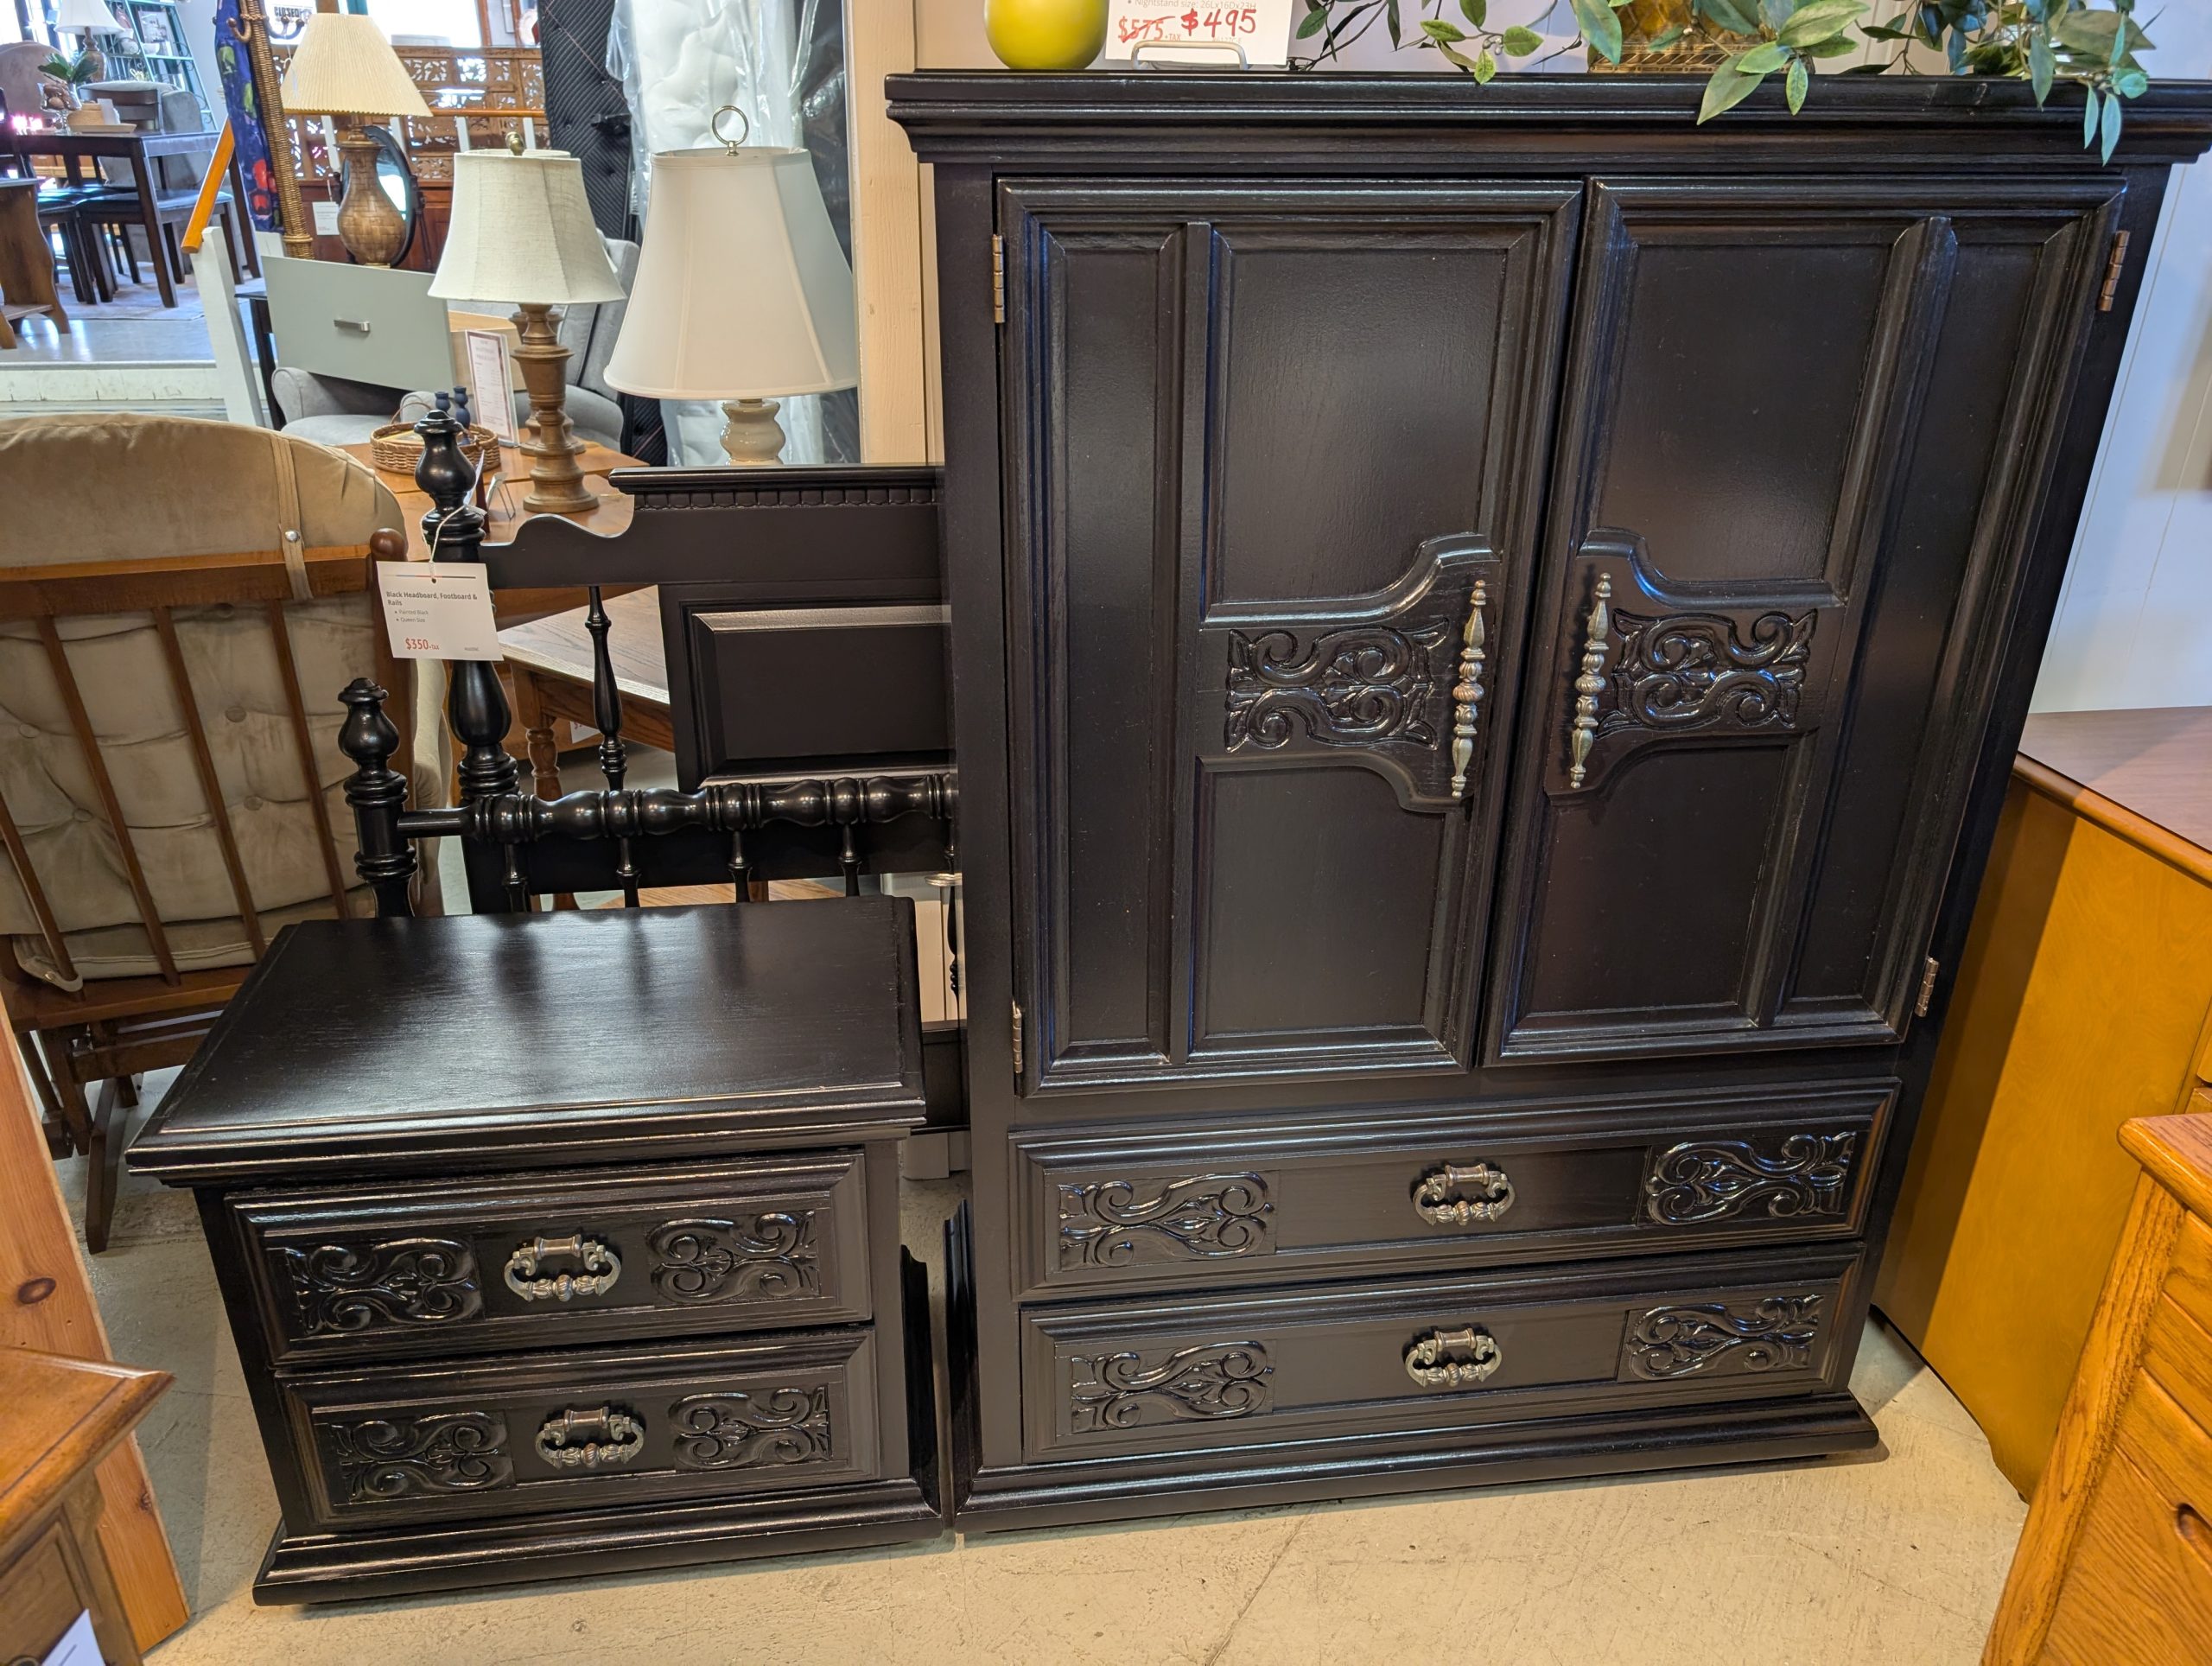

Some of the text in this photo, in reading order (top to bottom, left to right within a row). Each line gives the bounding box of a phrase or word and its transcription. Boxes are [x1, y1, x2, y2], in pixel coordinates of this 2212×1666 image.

[1200, 1, 1256, 10] 26Lx16Dx23H
[1180, 8, 1257, 38] $495
[405, 638, 429, 650] $350
